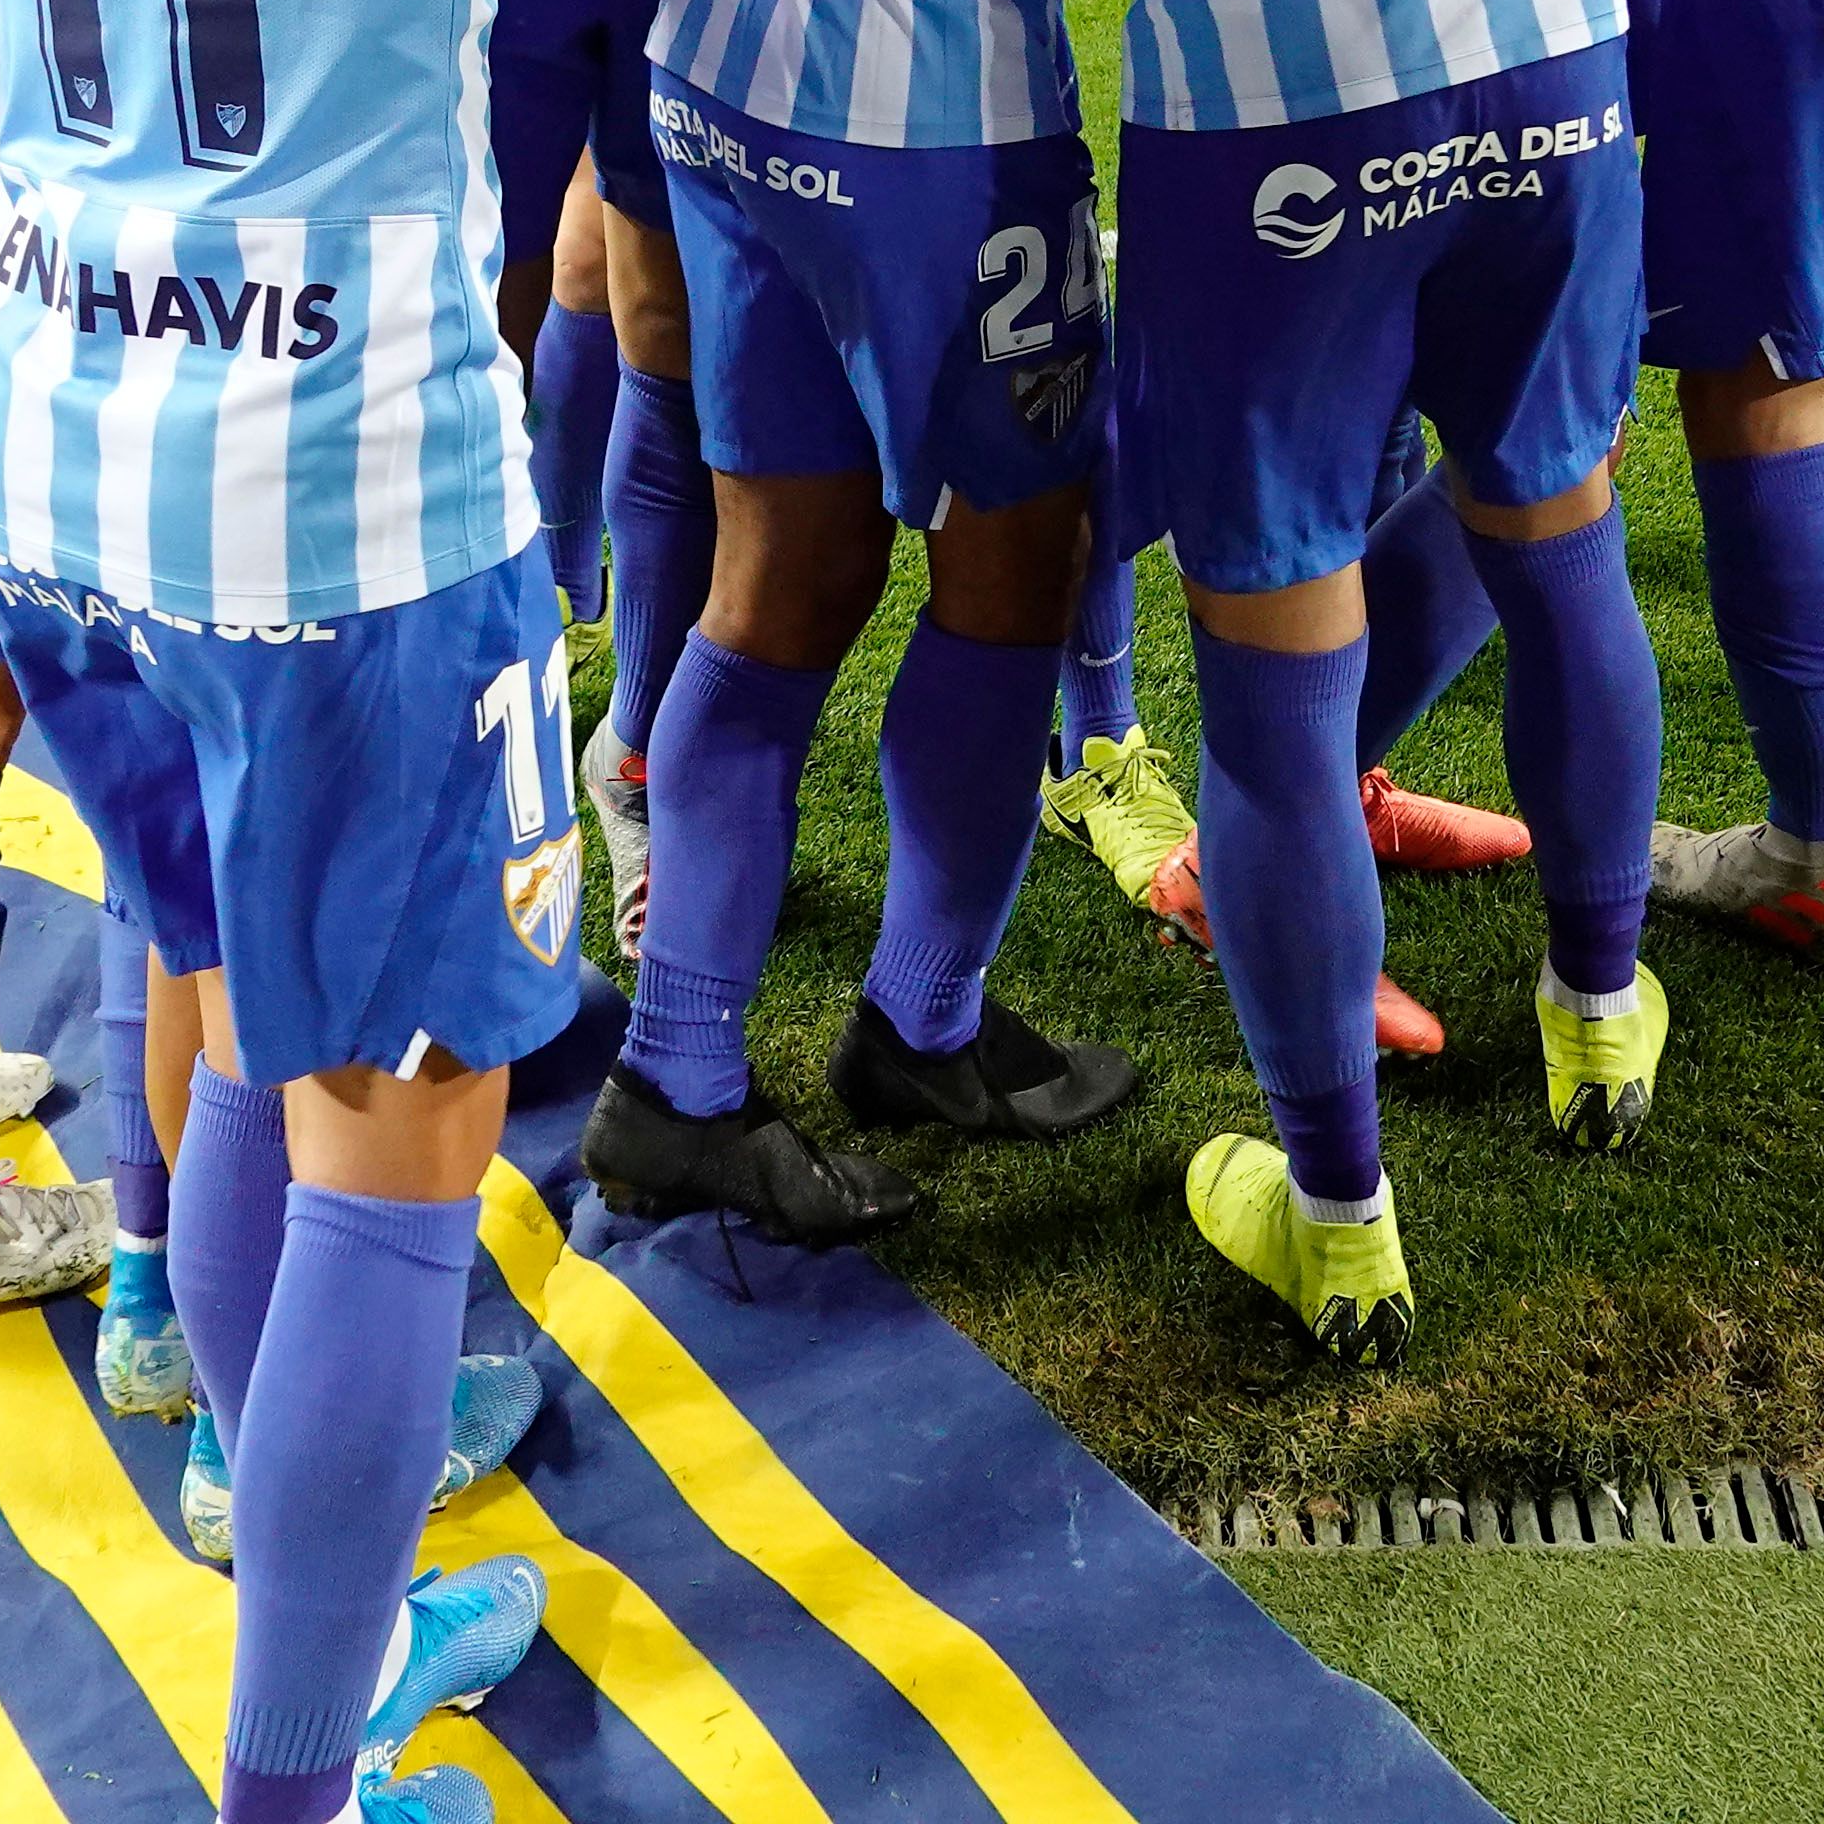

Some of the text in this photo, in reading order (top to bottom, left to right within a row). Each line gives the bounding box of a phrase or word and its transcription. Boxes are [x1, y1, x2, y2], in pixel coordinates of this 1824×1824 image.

[709, 122, 758, 183] DEL
[764, 156, 854, 208] SOL
[1358, 133, 1508, 195] COSTA
[1520, 119, 1597, 161] DEL
[1361, 168, 1544, 238] MÁLAGA
[977, 191, 1109, 364] 24
[475, 631, 576, 846] 11
